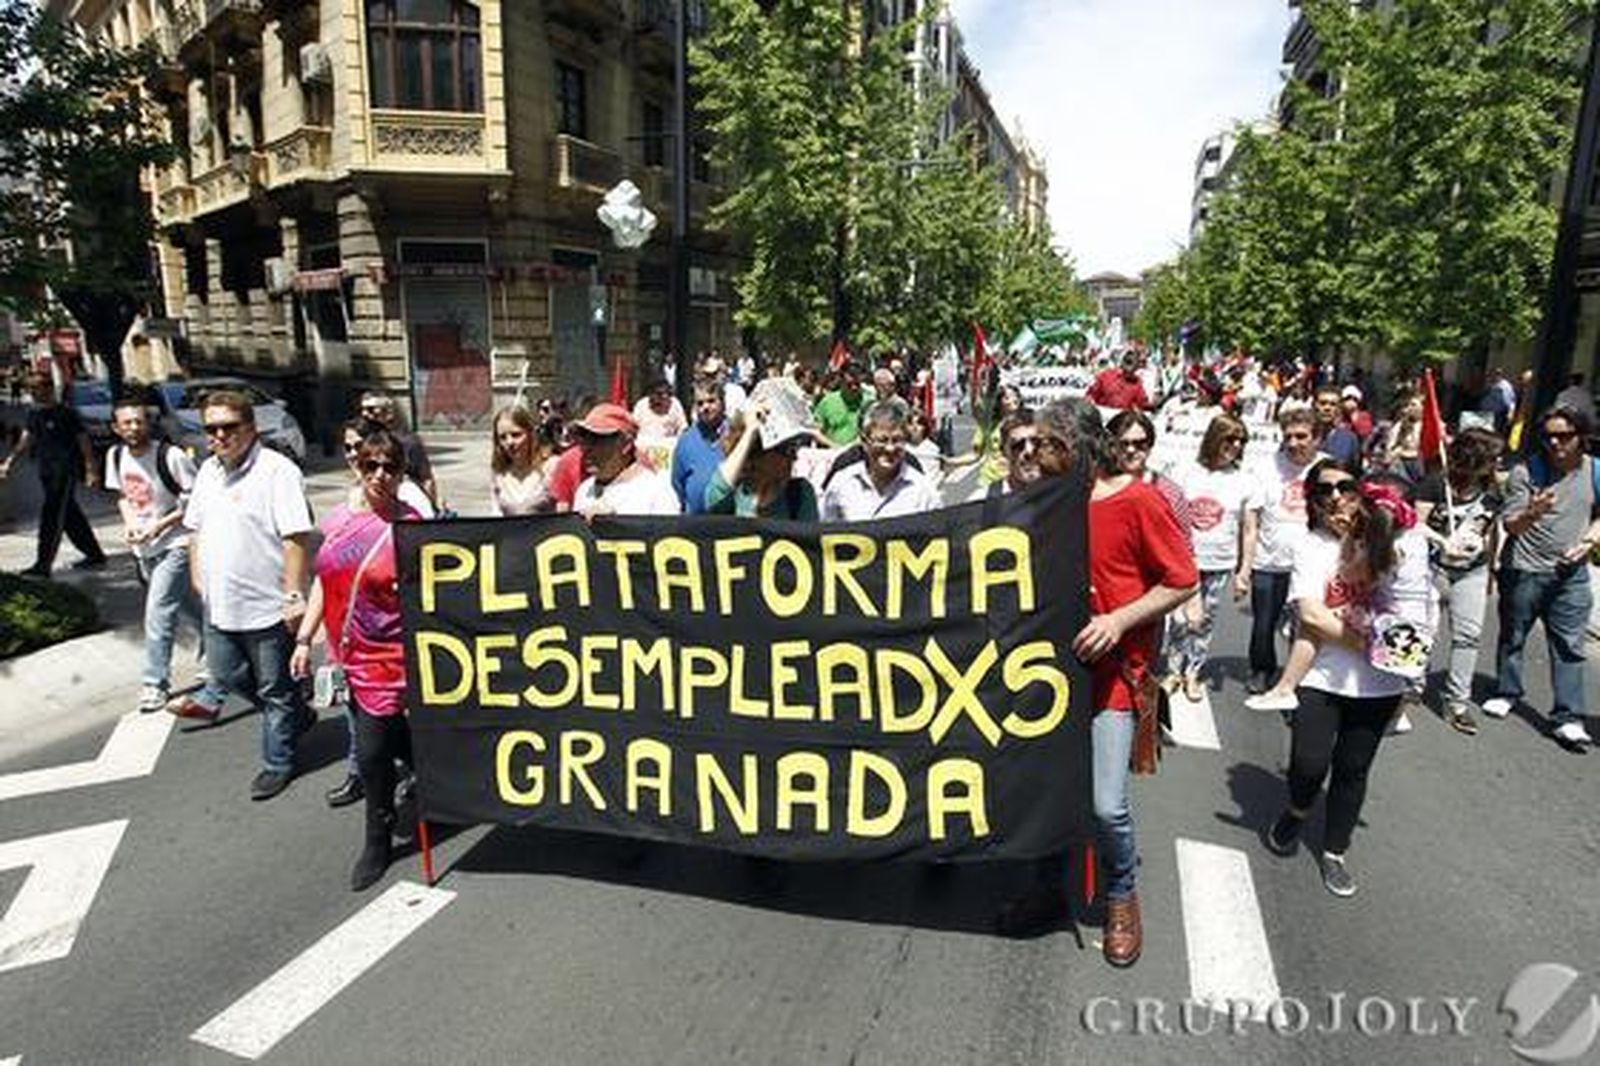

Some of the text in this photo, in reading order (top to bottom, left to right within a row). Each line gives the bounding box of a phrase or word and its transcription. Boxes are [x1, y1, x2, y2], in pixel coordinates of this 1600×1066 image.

[419, 526, 1035, 618] PLATAFORMA
[414, 625, 1071, 745] DESEMPLEADXS
[495, 730, 990, 839] GRANADA
